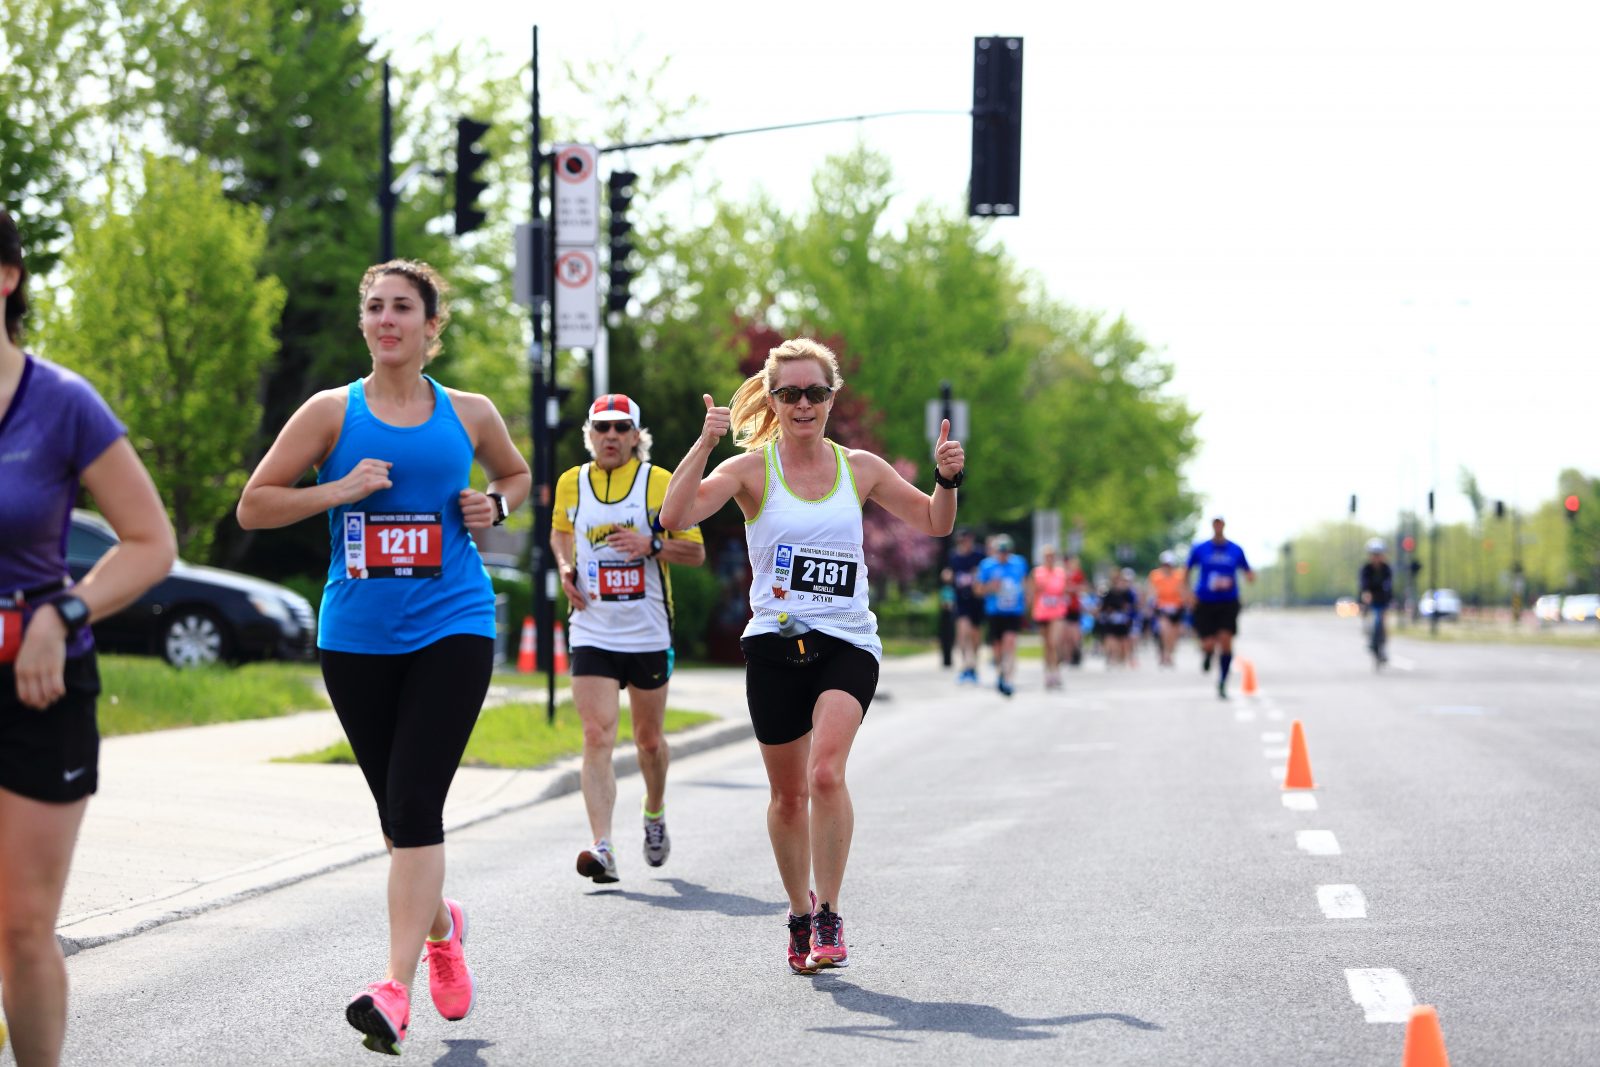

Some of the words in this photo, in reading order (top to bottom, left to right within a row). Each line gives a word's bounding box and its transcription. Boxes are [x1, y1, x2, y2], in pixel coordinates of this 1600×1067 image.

[377, 528, 428, 554] 1211
[604, 569, 640, 587] 1319
[775, 568, 790, 576] SSQ
[801, 560, 848, 586] 2131
[813, 585, 835, 593] MICHELLE
